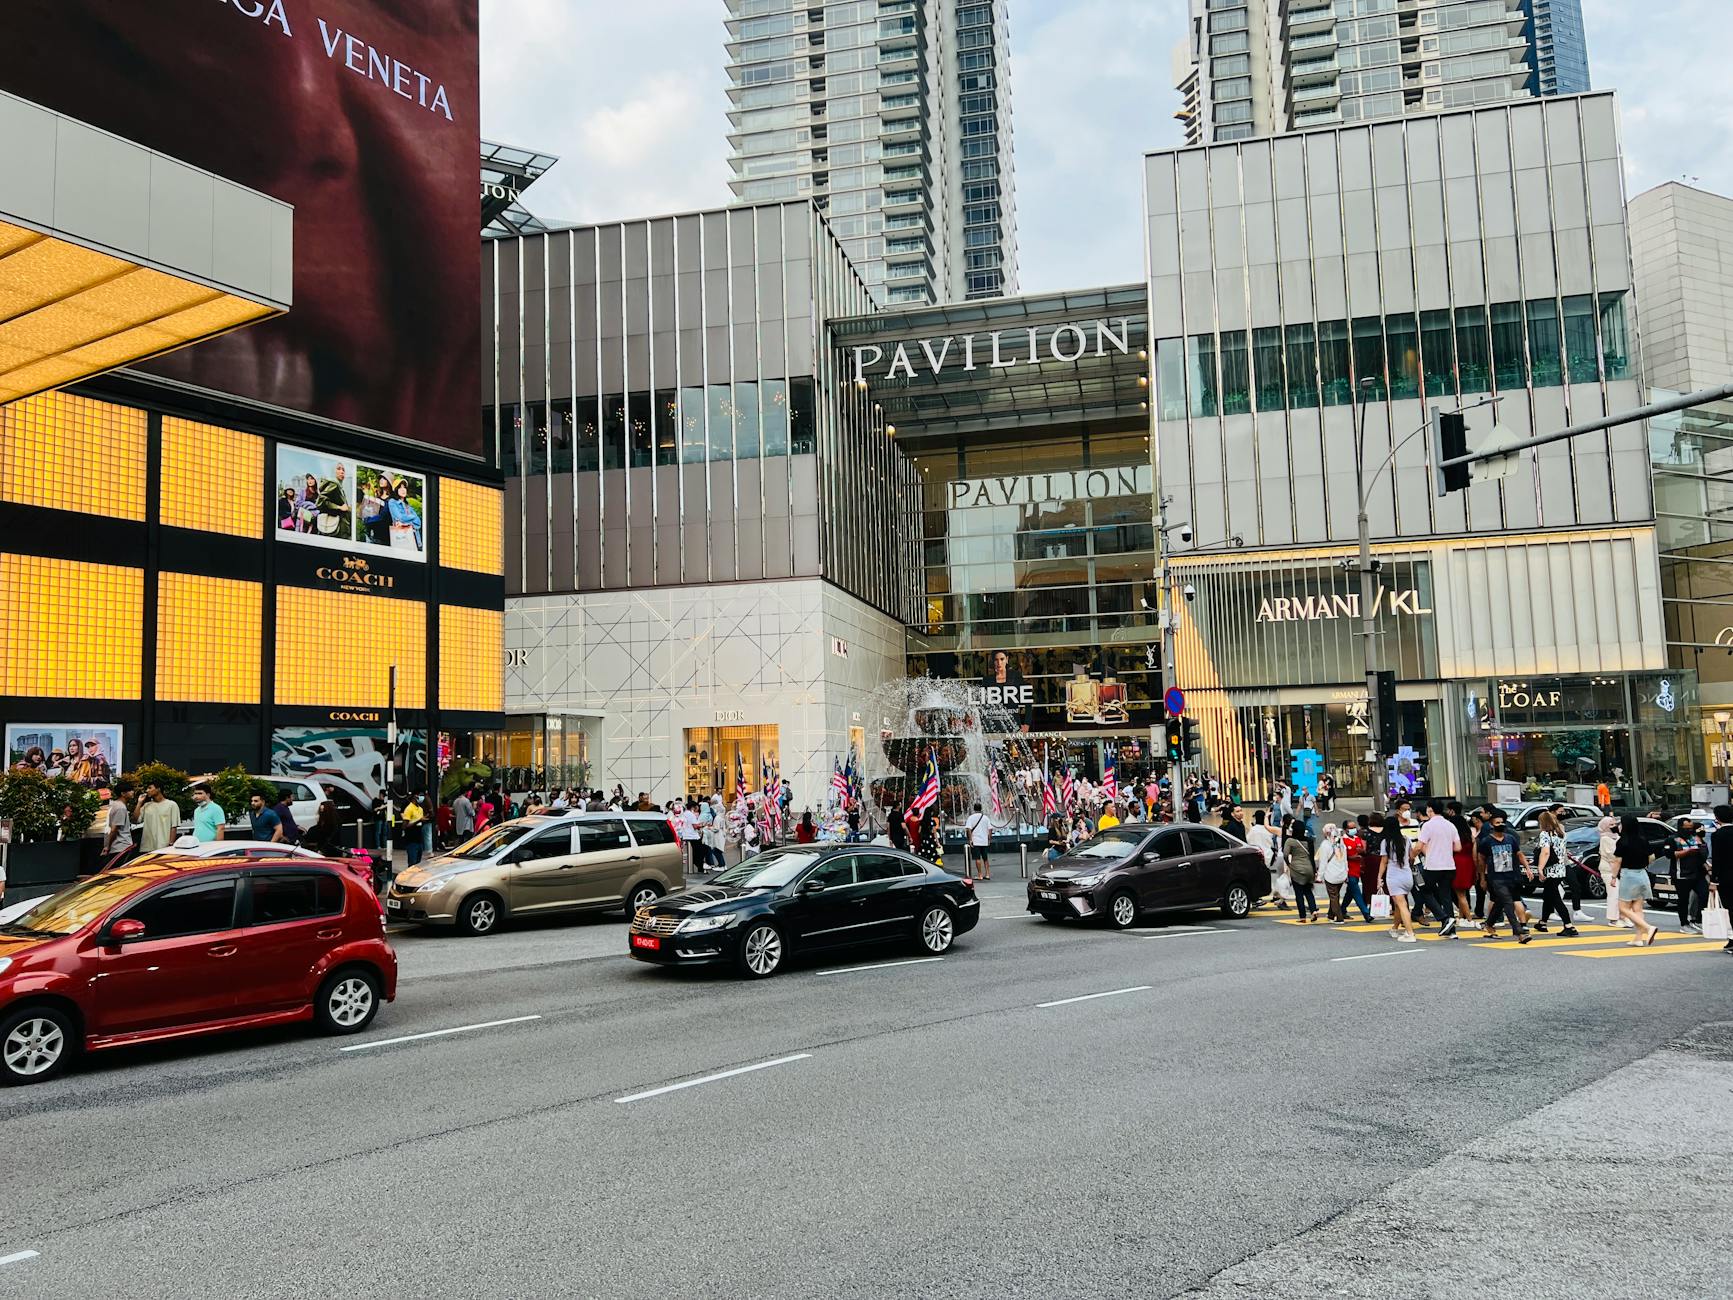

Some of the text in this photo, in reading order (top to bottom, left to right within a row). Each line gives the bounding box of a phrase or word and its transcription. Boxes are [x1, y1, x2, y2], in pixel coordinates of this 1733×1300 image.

[317, 18, 454, 121] VENETA
[852, 319, 1130, 382] PAVILION
[950, 466, 1139, 510] PAVILION
[316, 567, 394, 588] COACH
[1256, 593, 1361, 622] ARMANI
[967, 685, 1034, 705] LIBRE
[1499, 684, 1518, 694] The
[1499, 691, 1561, 708] LOAF
[329, 711, 379, 721] COACH
[715, 710, 744, 721] DIOR
